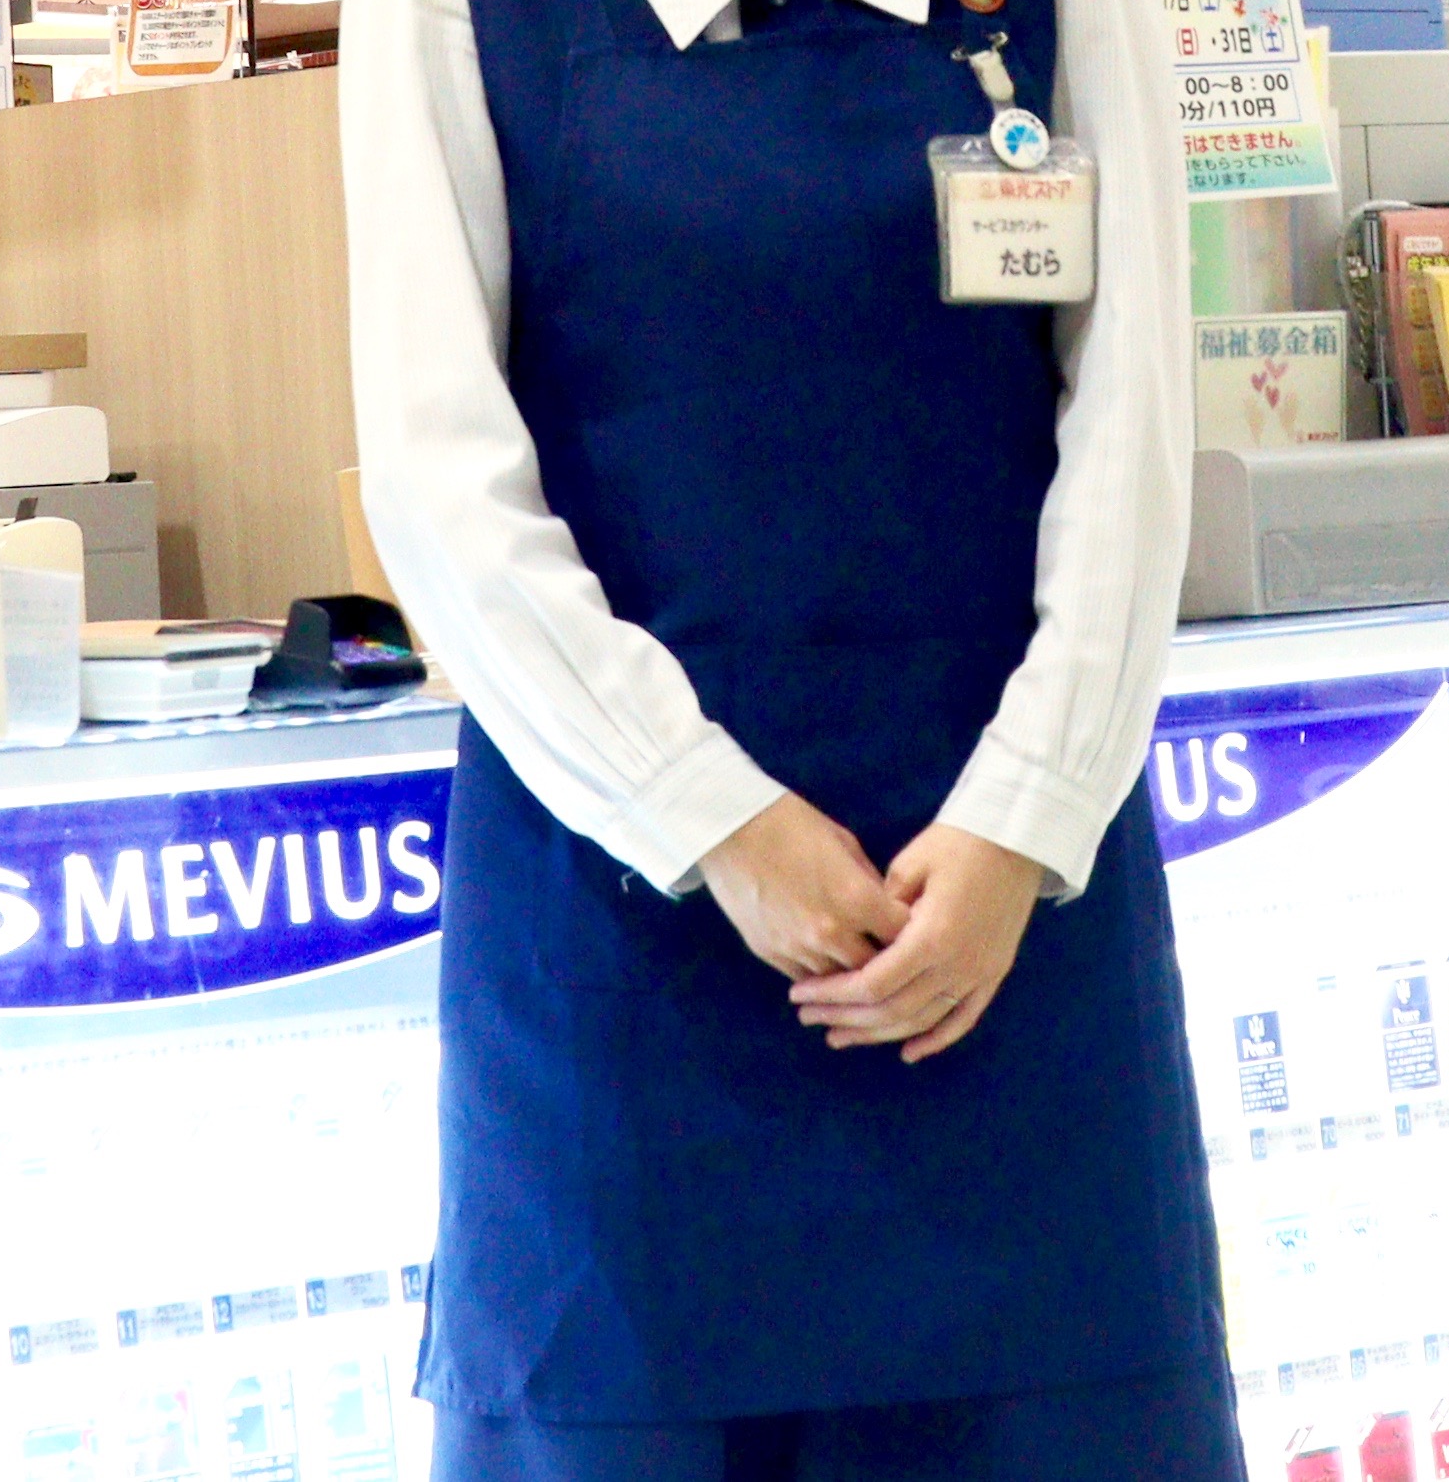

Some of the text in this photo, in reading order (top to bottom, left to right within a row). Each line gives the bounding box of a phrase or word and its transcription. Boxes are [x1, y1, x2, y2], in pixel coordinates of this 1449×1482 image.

[1186, 153, 1307, 171] をもらって下さい。
[1000, 248, 1061, 277] たむら
[1200, 324, 1338, 359] 福祉募金箱
[63, 817, 441, 954] MEVIUS
